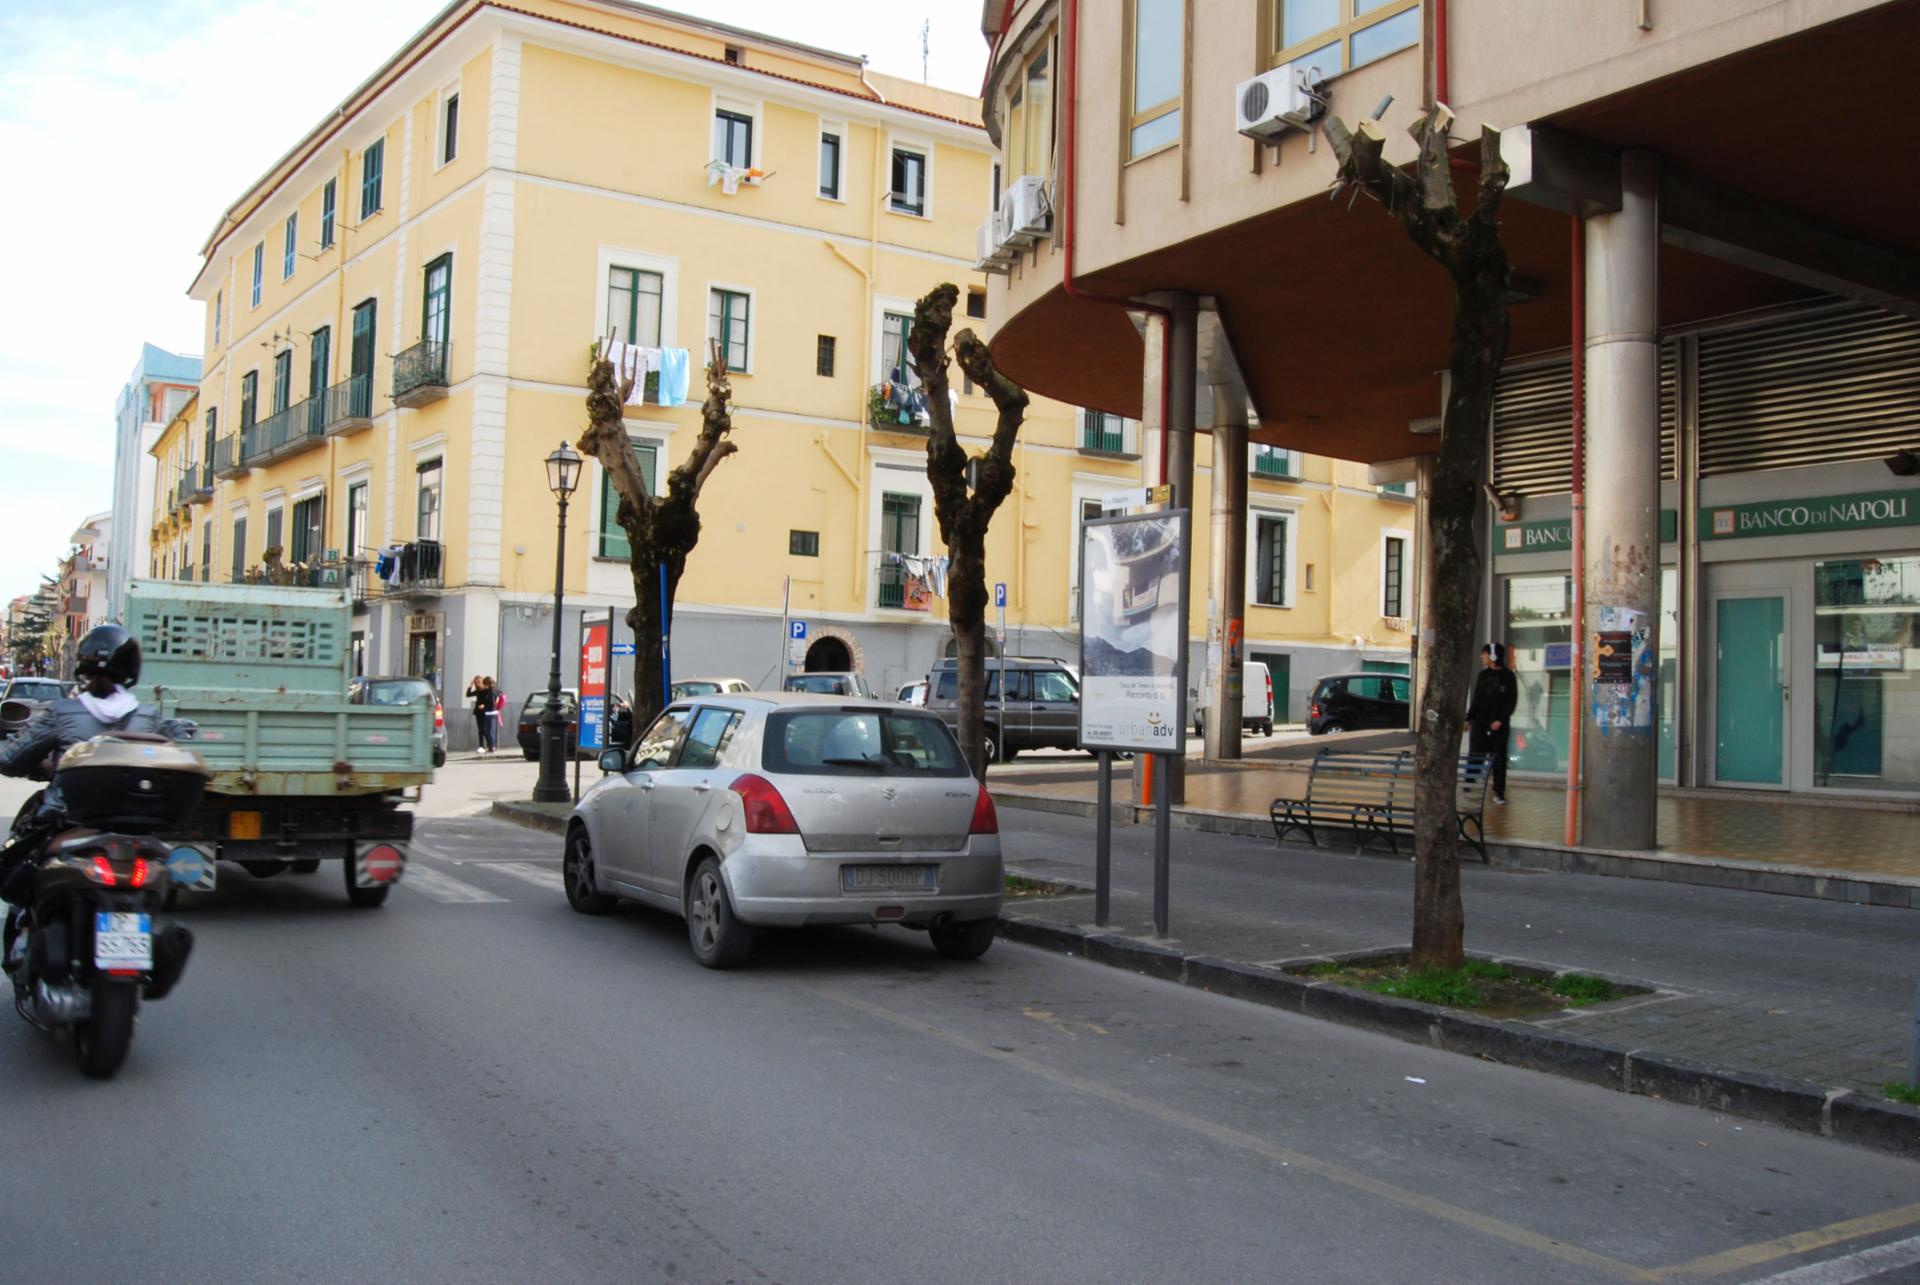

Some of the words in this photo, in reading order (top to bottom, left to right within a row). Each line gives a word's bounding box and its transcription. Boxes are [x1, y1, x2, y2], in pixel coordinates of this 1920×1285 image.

[1740, 506, 1809, 530] BANCO
[1811, 510, 1827, 524] DI
[1830, 497, 1907, 523] NAPOLI
[996, 585, 1004, 605] P
[793, 622, 804, 637] P
